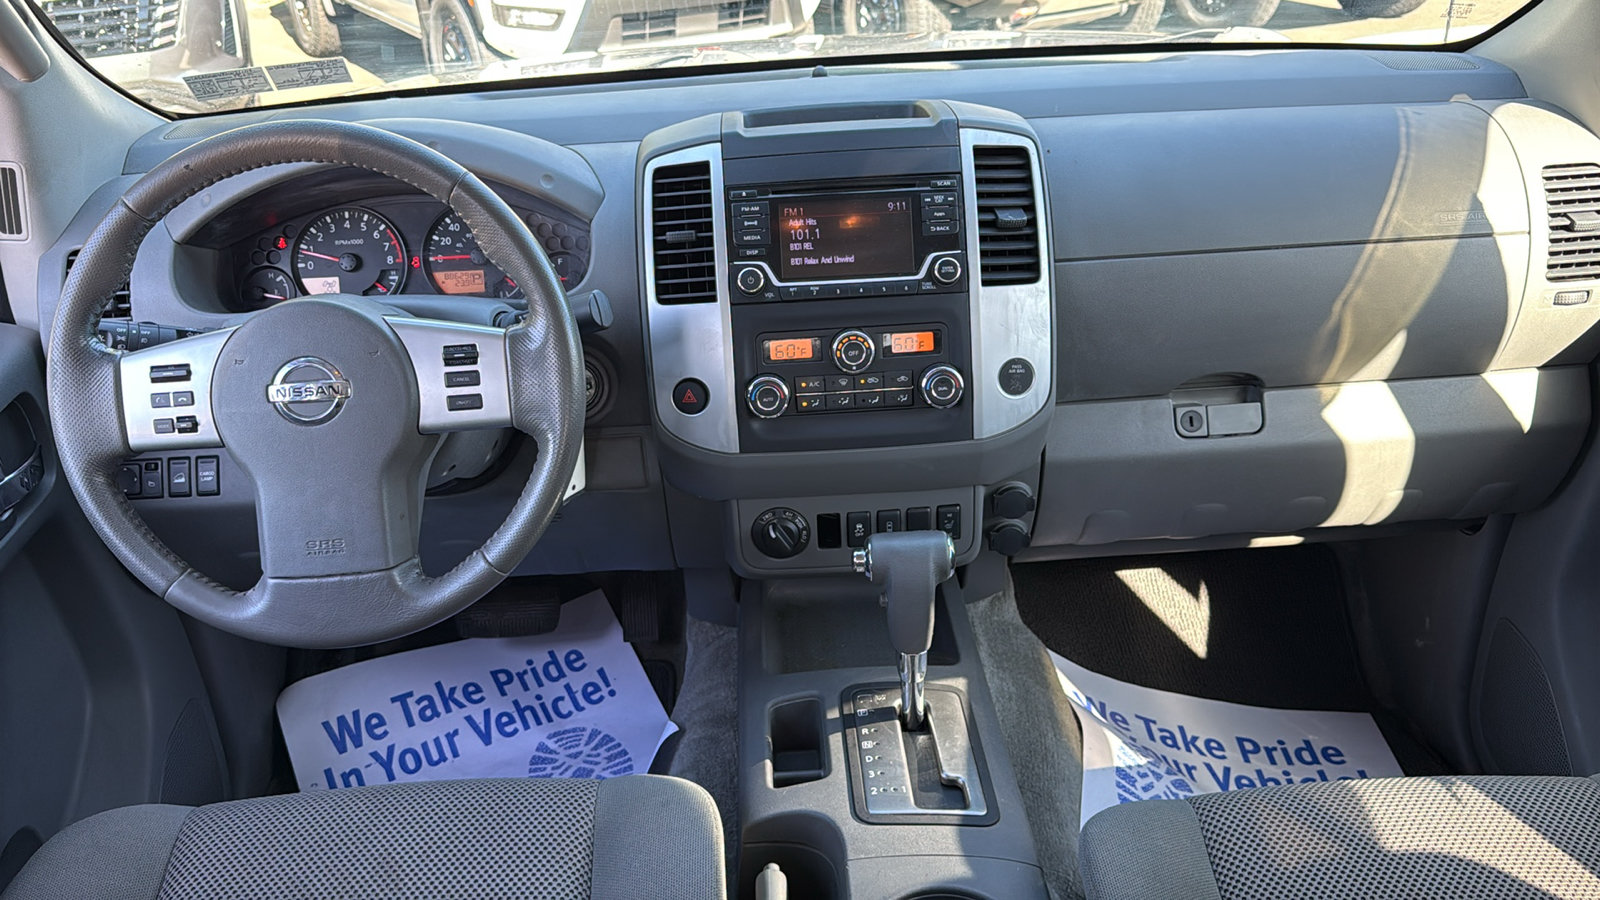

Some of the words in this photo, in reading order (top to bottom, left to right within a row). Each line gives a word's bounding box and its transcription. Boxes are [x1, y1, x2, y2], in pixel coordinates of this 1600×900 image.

[887, 201, 906, 211] 9:11
[783, 207, 798, 217] FM
[344, 220, 350, 229] 4
[360, 222, 367, 231] 5
[788, 218, 804, 227] Adult
[805, 217, 817, 226] Hits
[329, 224, 336, 233] 3
[448, 223, 460, 232] 40
[317, 233, 323, 241] 2
[373, 230, 380, 239] 6
[790, 227, 820, 240] 101.1
[440, 237, 452, 245] 20
[383, 242, 390, 251] 7
[386, 256, 394, 264] 8
[834, 254, 855, 263] Unwind
[307, 261, 314, 270] 0
[276, 385, 340, 398] NISSAN
[305, 538, 346, 550] SRS
[320, 708, 390, 756] We
[390, 680, 487, 729] Take
[489, 648, 588, 698] Pride
[323, 767, 366, 790] In
[369, 727, 460, 783] Your
[463, 666, 617, 747] Vehicle!
[1134, 713, 1228, 761] Take
[1235, 736, 1347, 767] Pride
[865, 755, 873, 763] D
[868, 770, 875, 778] 3
[870, 786, 878, 795] 2
